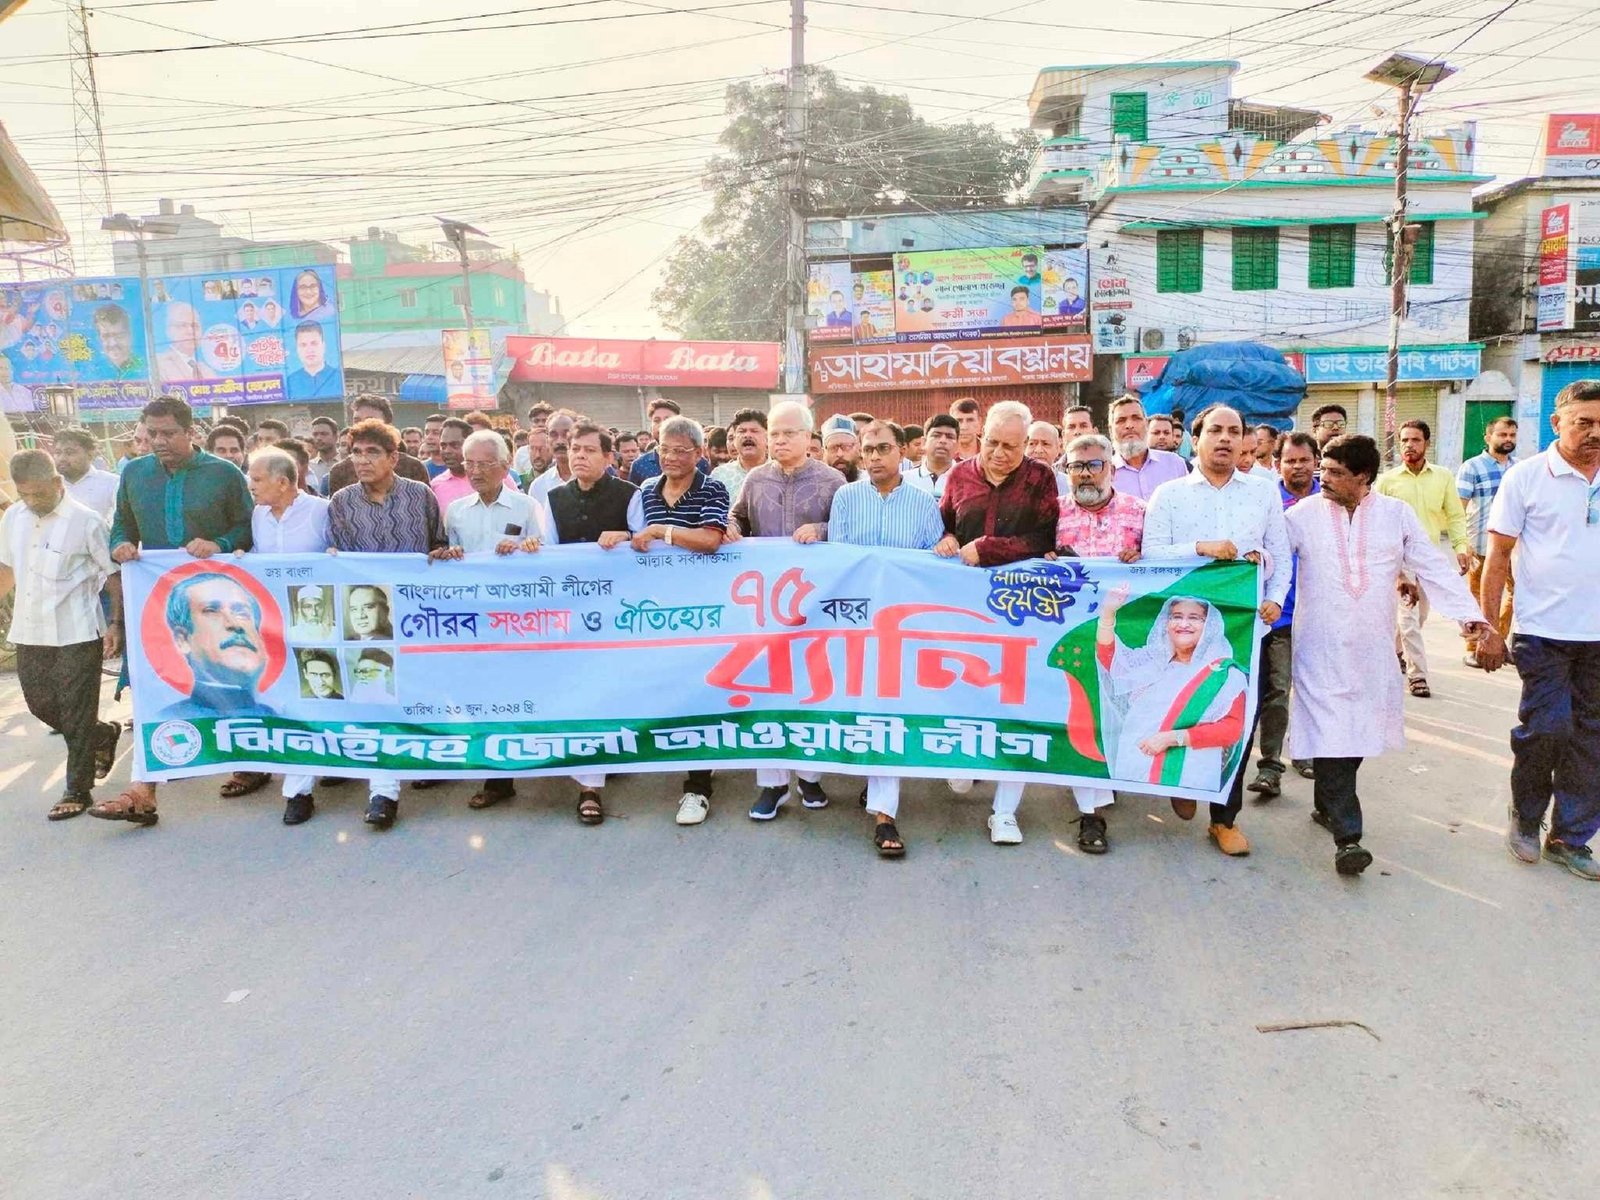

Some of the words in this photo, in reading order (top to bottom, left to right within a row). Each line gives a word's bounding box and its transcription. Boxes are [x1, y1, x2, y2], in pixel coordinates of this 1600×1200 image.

[526, 342, 621, 368] Bata
[664, 346, 759, 372] Bata
[1314, 353, 1350, 373] ভাই
[1352, 353, 1389, 373] ভাই
[1429, 350, 1478, 372] পার্টস
[264, 567, 282, 578] জয়
[286, 566, 313, 578] বাংলা
[636, 554, 673, 568] আল্লাহ
[1129, 566, 1148, 575] জয়
[397, 582, 480, 601] বাংলাদেশ
[485, 575, 556, 598] আওয়ামী
[562, 574, 613, 597] লীগের
[400, 603, 480, 639] গৌরব
[485, 608, 573, 637] সংগ্রাম
[581, 611, 602, 632] ও
[614, 598, 725, 634] ঐতিহ্যের
[730, 566, 816, 628] ৭৫
[819, 598, 872, 624] বছর
[989, 586, 1070, 621] জয়ন্তী
[402, 702, 434, 715] তারিখ
[445, 704, 462, 715] ২৩
[492, 703, 520, 715] ২০২৪
[212, 717, 471, 763] ঝিনাইদহ
[484, 726, 639, 762] জেলা
[650, 715, 909, 757] আওয়ামী
[919, 718, 1053, 763] লীগ
